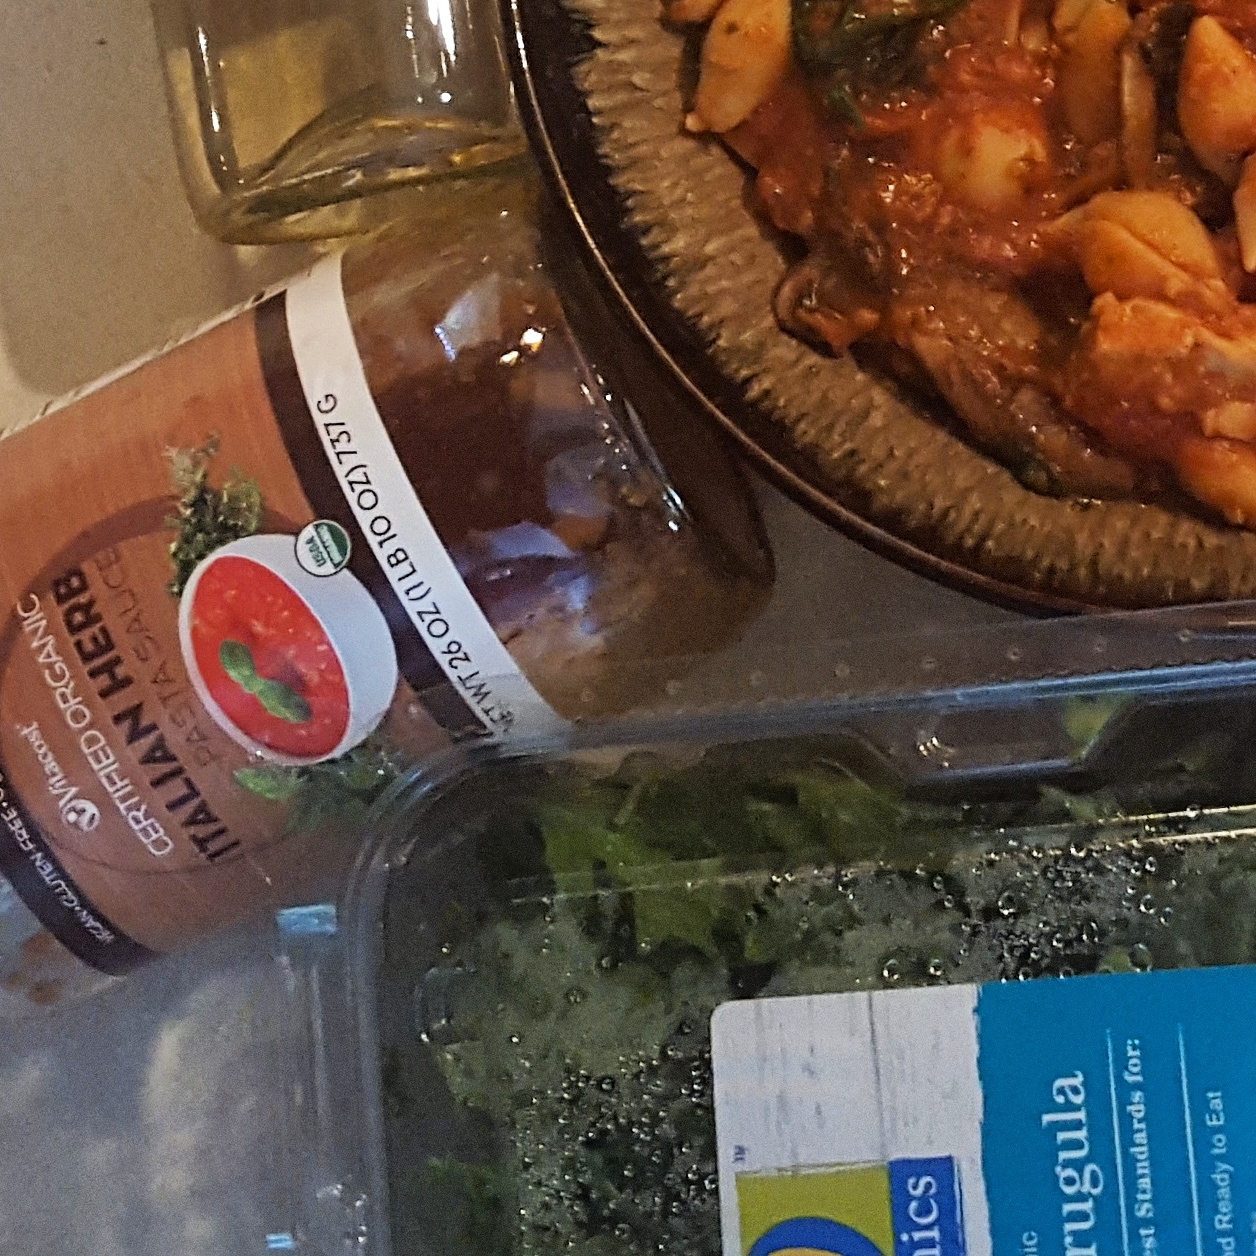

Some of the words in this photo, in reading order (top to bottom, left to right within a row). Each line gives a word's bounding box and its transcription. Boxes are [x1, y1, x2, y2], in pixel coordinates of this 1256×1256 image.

[316, 392, 339, 416] G
[323, 420, 358, 466] 737
[343, 462, 381, 513] OZ)
[368, 514, 398, 547] 10
[386, 546, 418, 584] LB
[52, 567, 134, 700] HERB
[416, 600, 452, 640] OZ
[16, 592, 91, 729] ORGANIC
[440, 640, 472, 670] 26
[457, 669, 496, 708] WT
[80, 729, 174, 857] CERTIFIED
[110, 701, 242, 862] ITALIAN
[1125, 1037, 1143, 1085] for:
[1204, 1089, 1224, 1128] Eat
[1041, 1069, 1105, 1256] rugula
[1124, 1087, 1156, 1222] Standards
[1209, 1134, 1228, 1156] to
[1213, 1158, 1235, 1228] Ready
